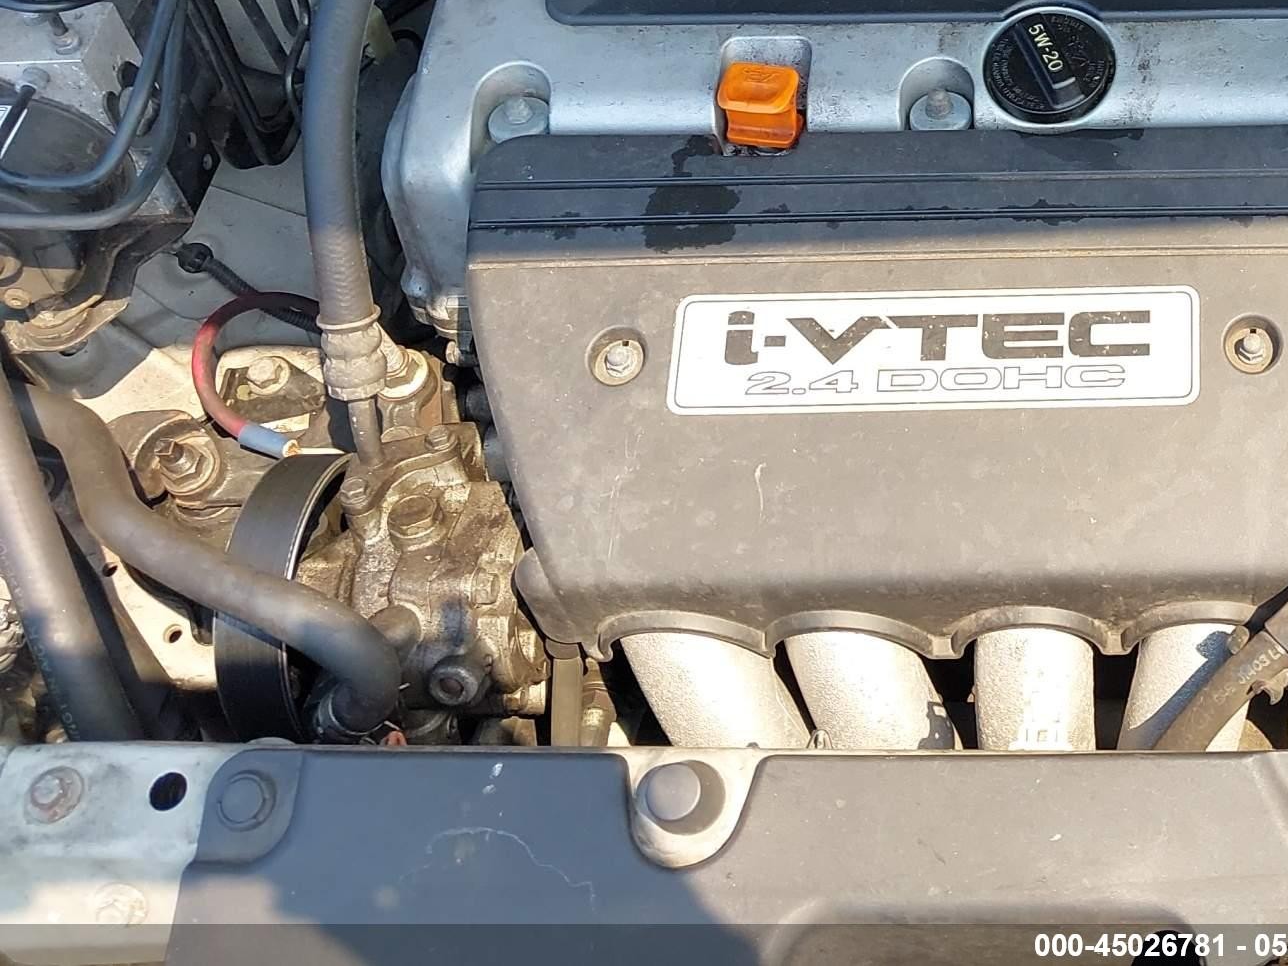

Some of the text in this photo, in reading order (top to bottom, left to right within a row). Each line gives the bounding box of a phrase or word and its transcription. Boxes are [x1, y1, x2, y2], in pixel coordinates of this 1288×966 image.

[1028, 23, 1063, 73] 5W-20
[724, 310, 1150, 366] i-VTEC
[744, 364, 1126, 396] 2.4 DOHC
